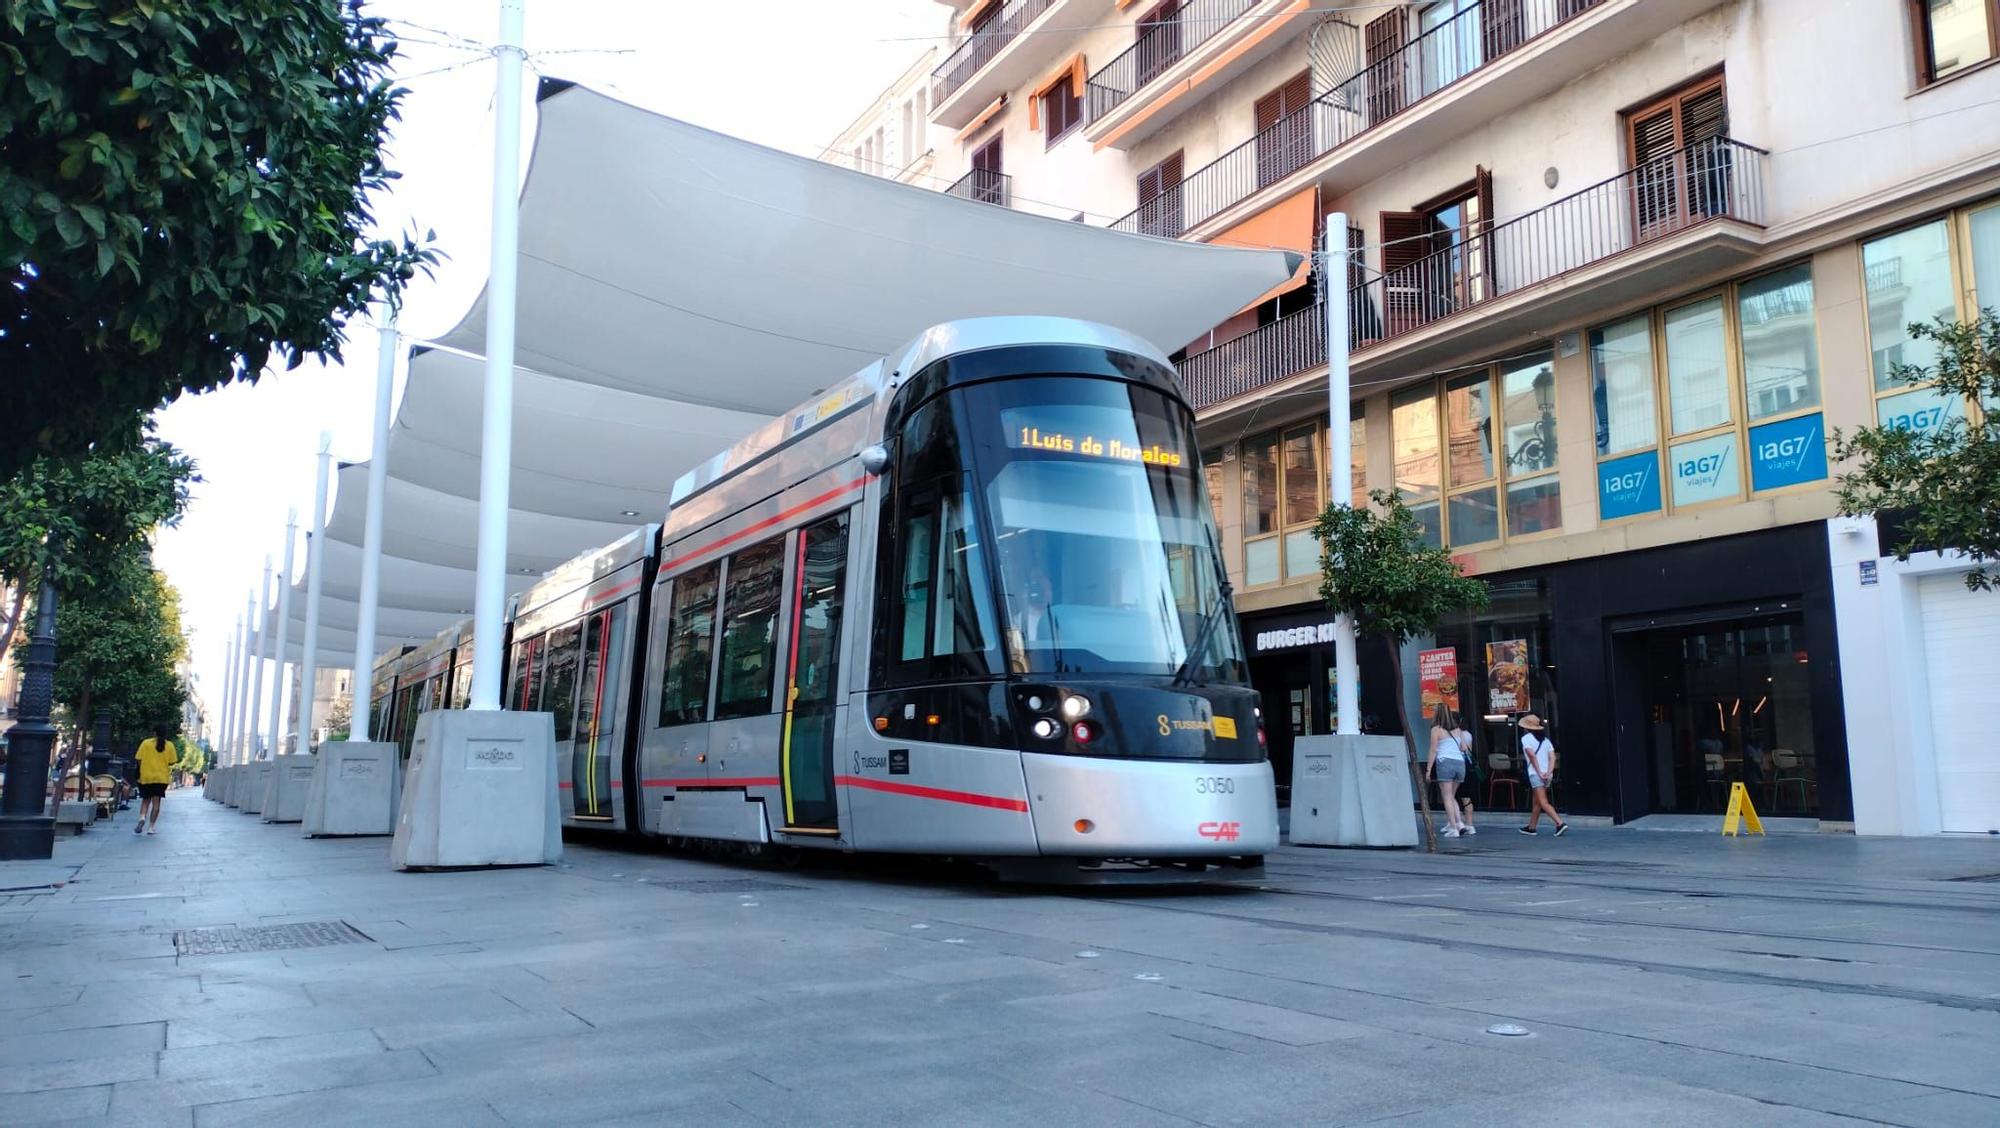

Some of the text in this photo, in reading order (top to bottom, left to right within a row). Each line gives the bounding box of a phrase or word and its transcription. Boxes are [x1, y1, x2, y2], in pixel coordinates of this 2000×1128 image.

[1081, 436, 1103, 455] de
[1110, 440, 1181, 465] Morales
[1768, 460, 1796, 470] viajes
[1687, 477, 1713, 487] viajes
[1257, 626, 1318, 651] BURGER
[861, 756, 887, 769] TUSSAM
[1195, 777, 1234, 794] 3050
[1198, 822, 1241, 841] CAF
